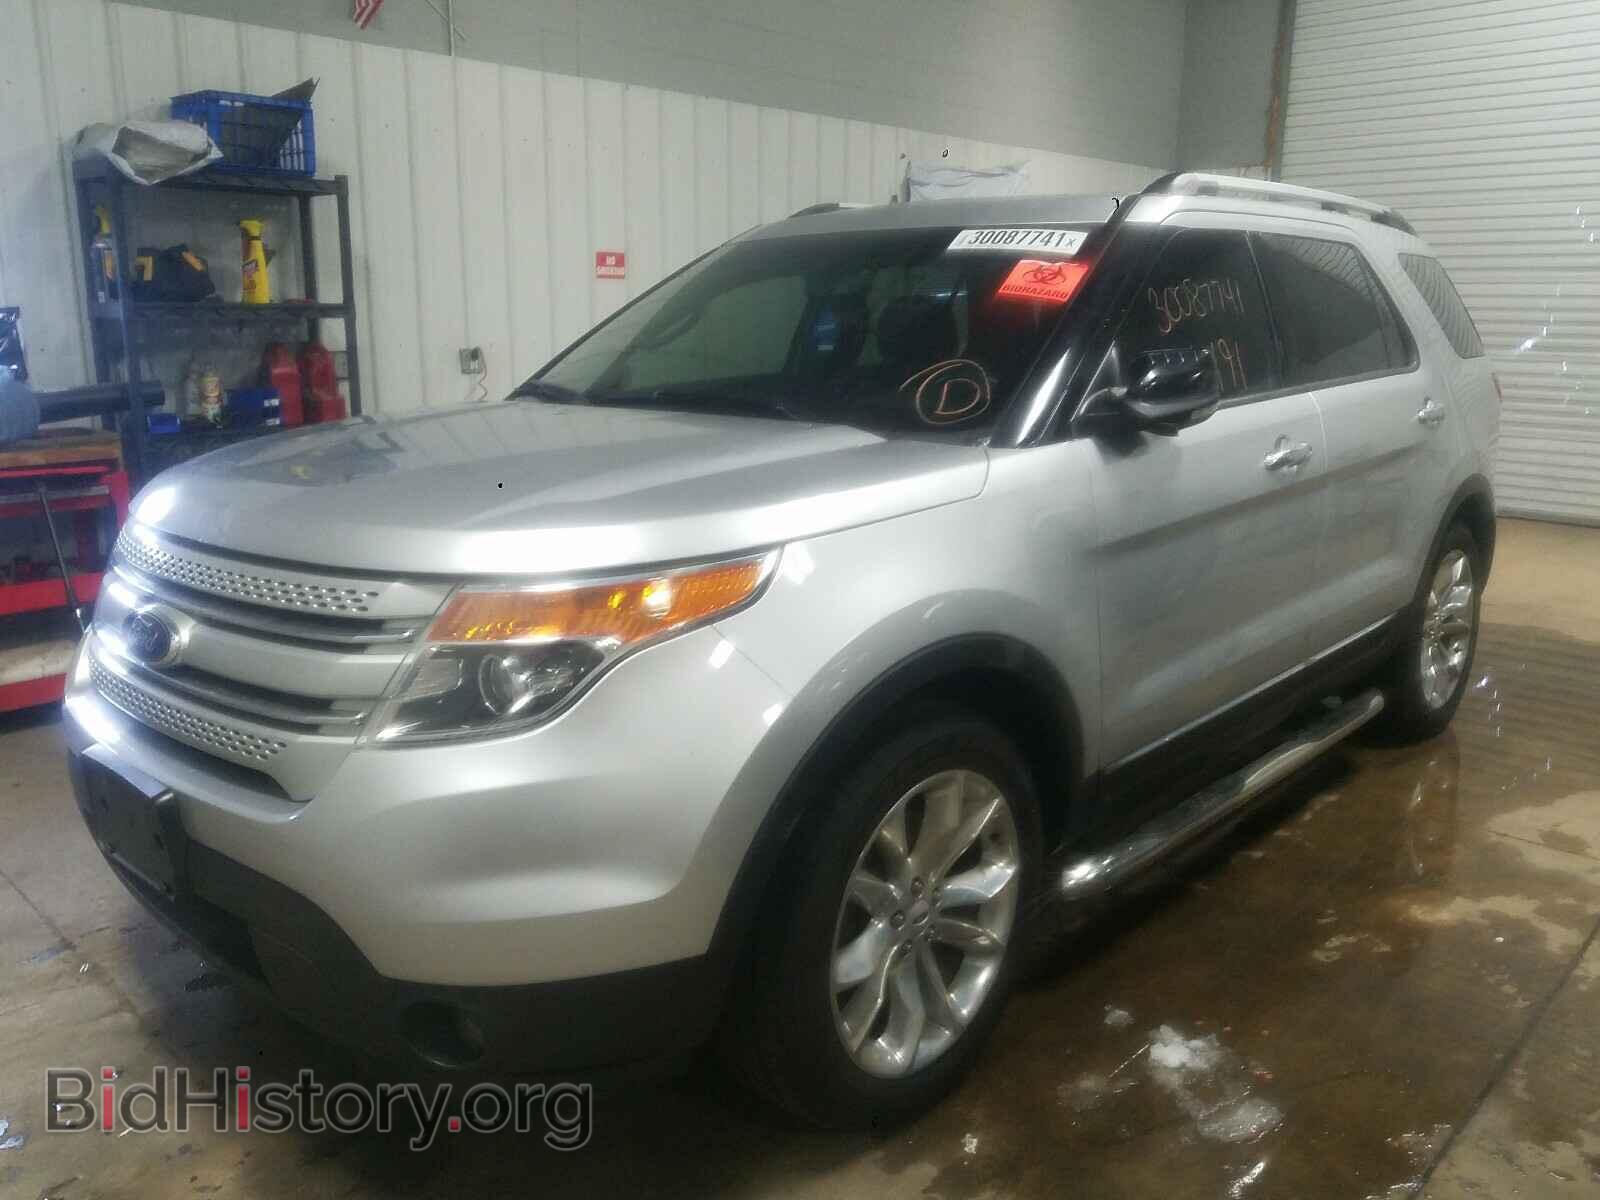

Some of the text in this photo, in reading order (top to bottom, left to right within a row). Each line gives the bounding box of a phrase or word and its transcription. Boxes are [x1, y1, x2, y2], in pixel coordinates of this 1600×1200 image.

[968, 230, 1067, 247] 30087741
[1001, 284, 1069, 299] BIOHAZARD
[934, 377, 981, 415] D
